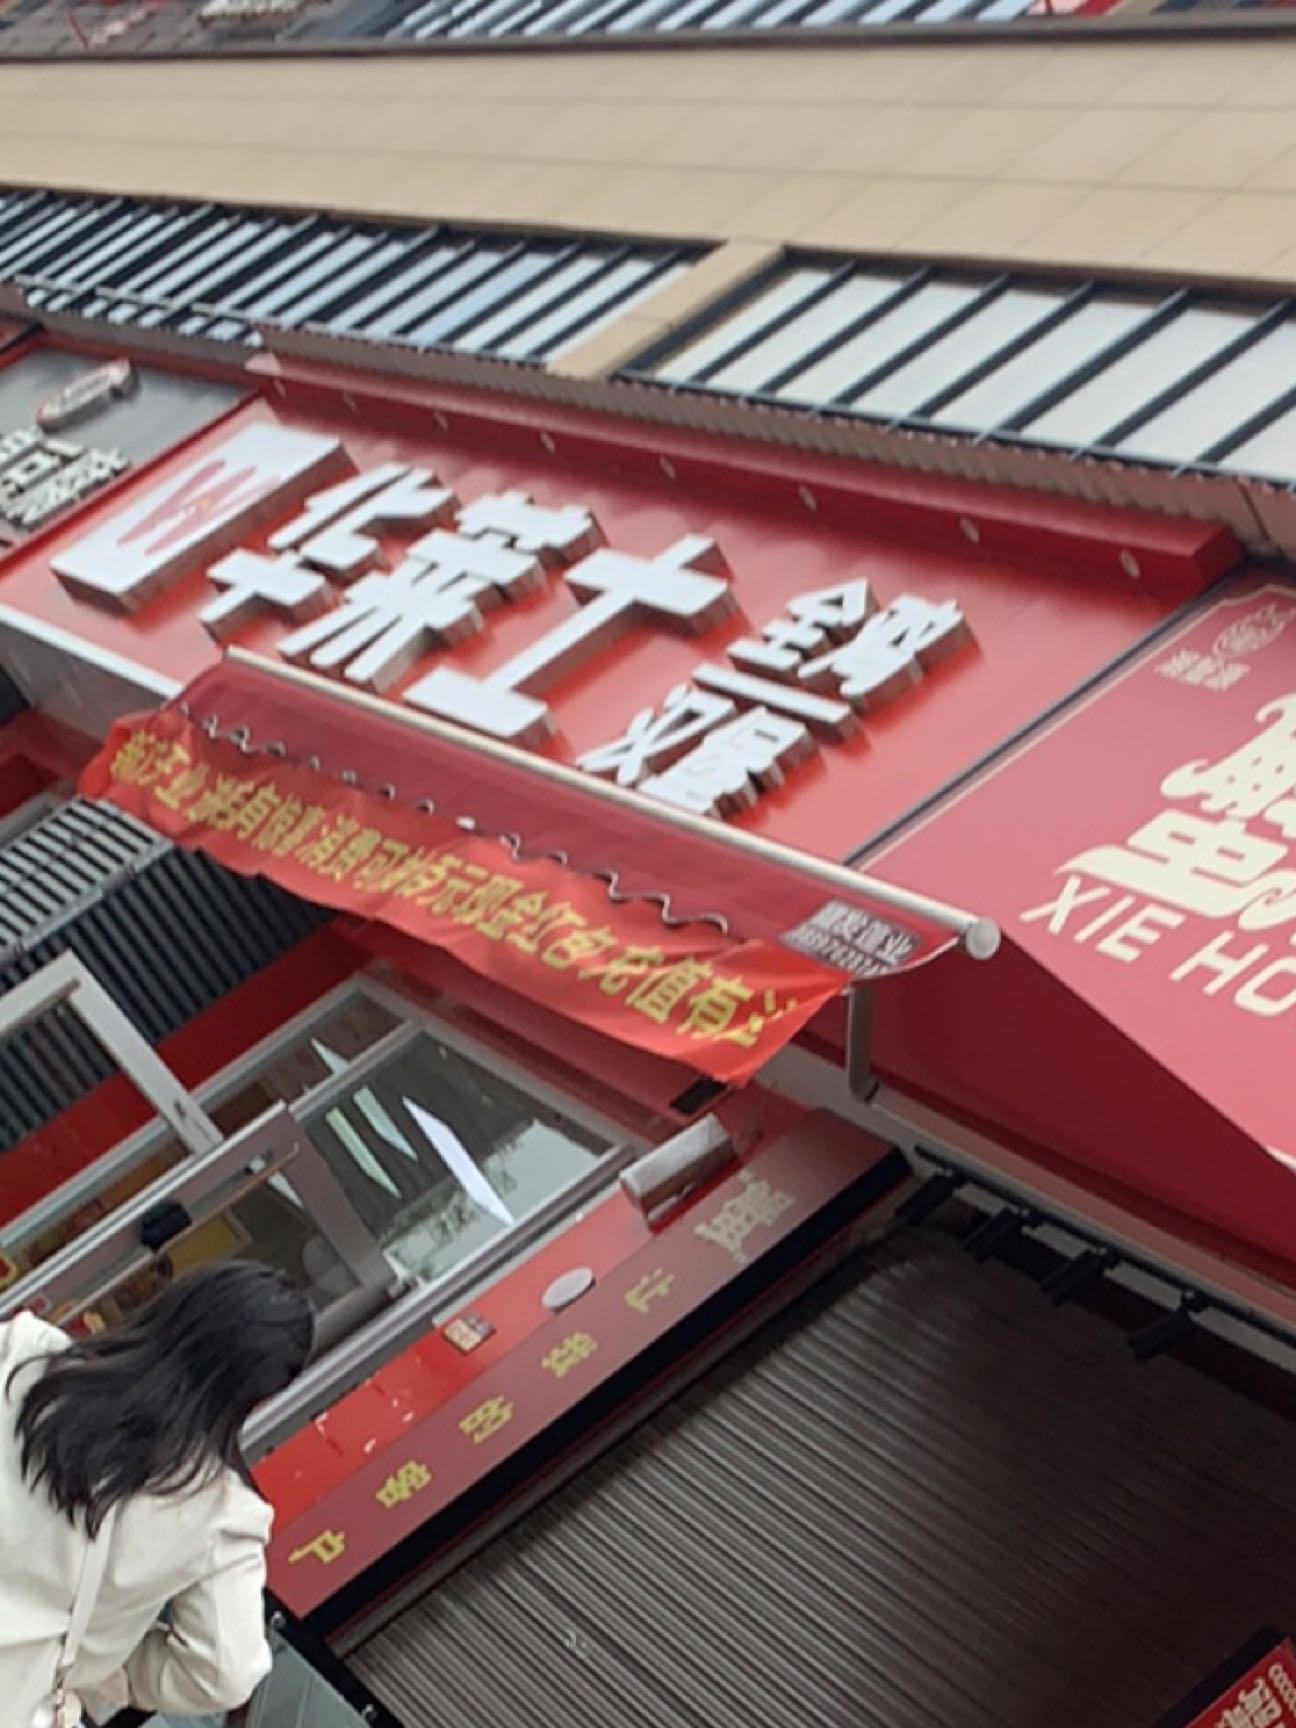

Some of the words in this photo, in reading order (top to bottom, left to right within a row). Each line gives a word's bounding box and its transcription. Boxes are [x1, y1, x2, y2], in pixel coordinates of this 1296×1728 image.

[200, 461, 735, 740] 华莱士
[576, 682, 812, 820] 汉堡
[1019, 876, 1186, 964] XIE
